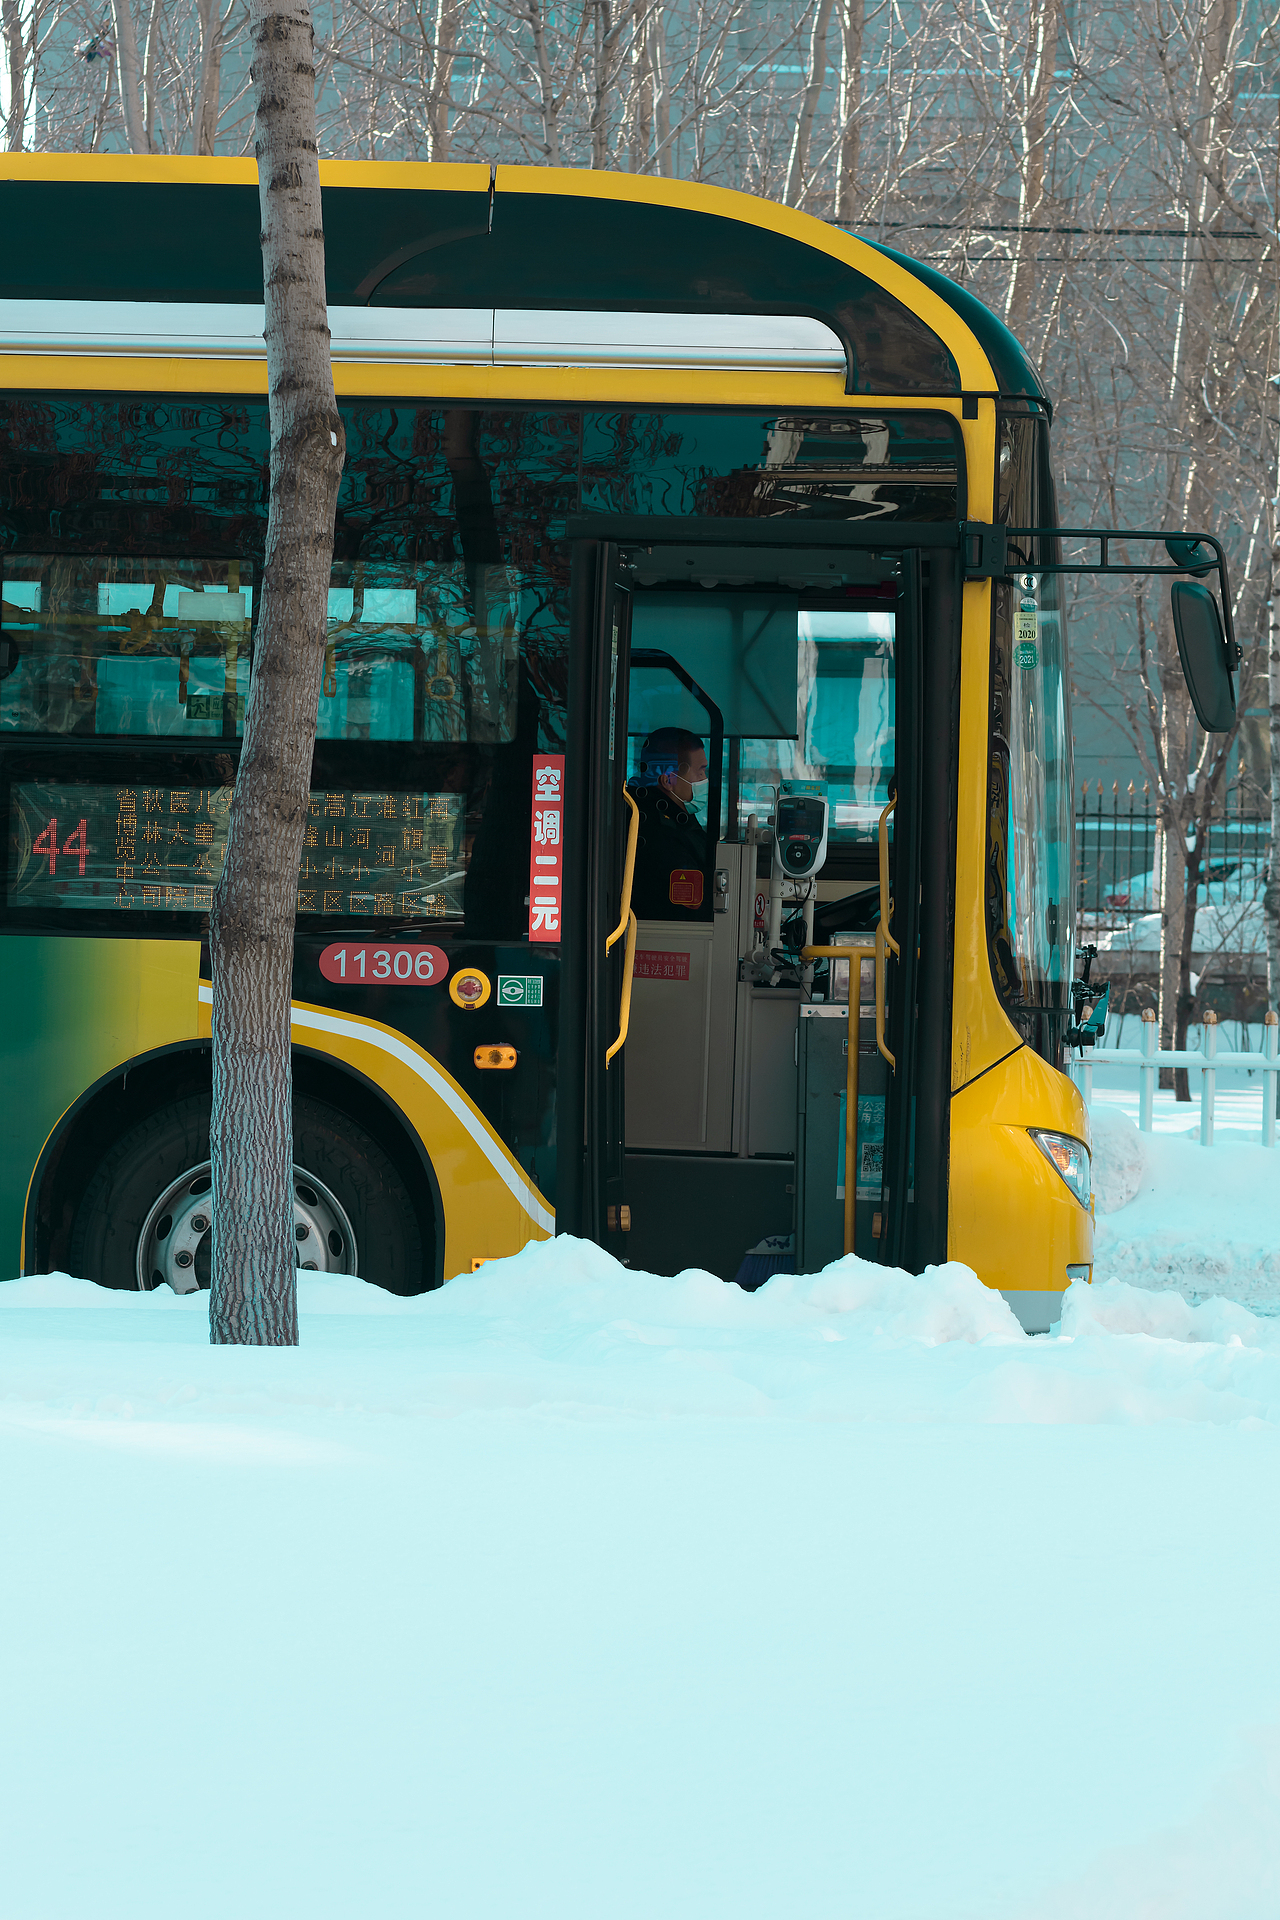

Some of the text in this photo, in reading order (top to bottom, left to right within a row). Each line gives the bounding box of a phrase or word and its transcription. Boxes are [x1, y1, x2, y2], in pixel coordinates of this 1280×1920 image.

[1018, 629, 1036, 639] 2020
[1019, 655, 1034, 664] 2021
[32, 817, 91, 876] 44
[113, 788, 138, 909] 省博览中心
[140, 789, 164, 908] 秋林公司
[165, 790, 190, 908] 医大一院
[192, 790, 216, 909] 儿童公园
[323, 793, 346, 912] 嵩山小区
[348, 794, 372, 913] 辽河小区
[374, 795, 398, 915] 淮河路
[401, 795, 424, 914] 红旗小区
[531, 765, 561, 931] 空调二元
[333, 949, 434, 979] 11306
